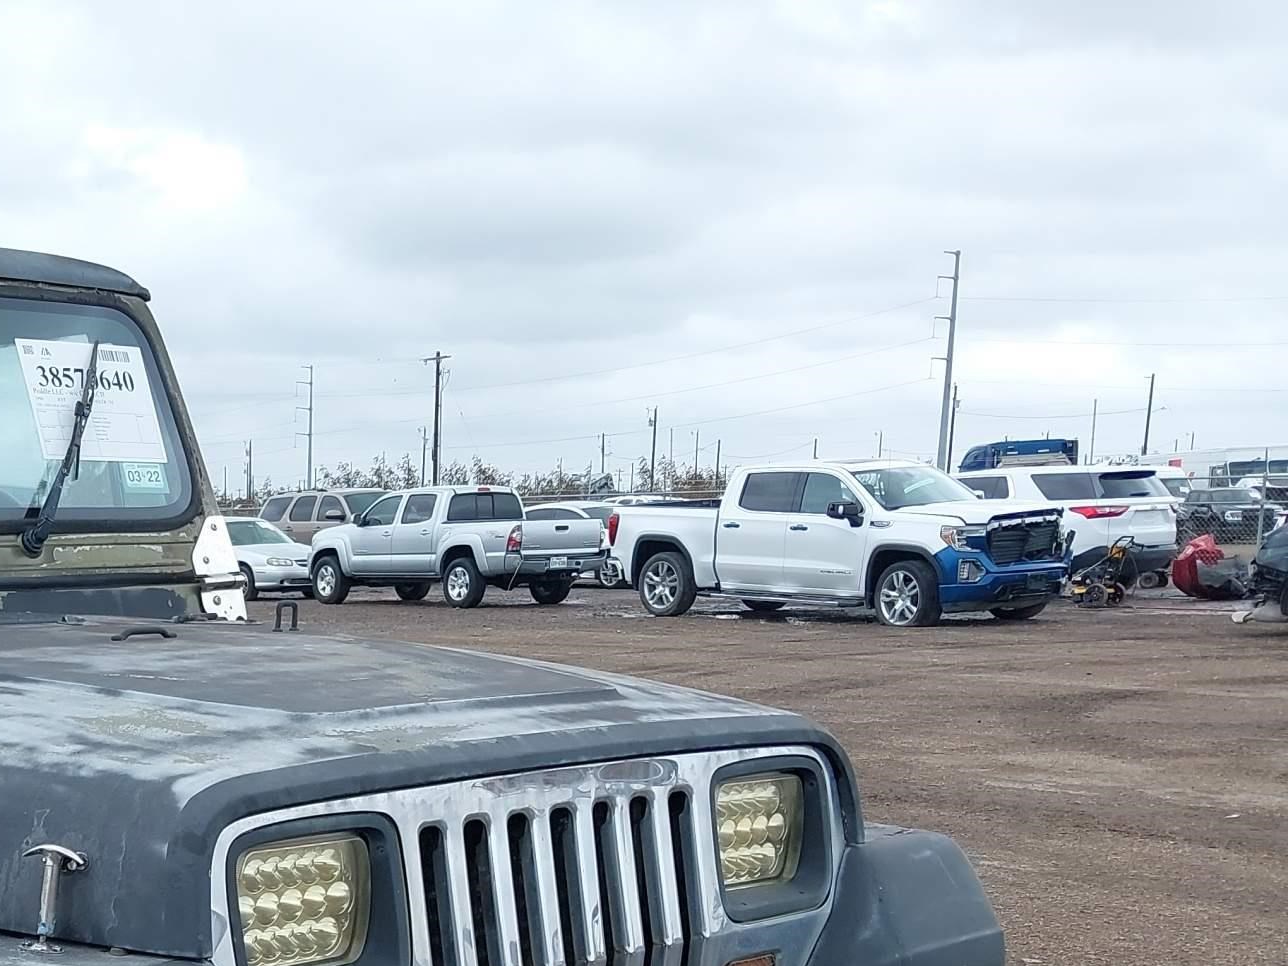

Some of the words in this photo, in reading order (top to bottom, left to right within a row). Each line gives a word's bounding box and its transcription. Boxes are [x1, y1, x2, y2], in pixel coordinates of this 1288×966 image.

[35, 365, 134, 392] 3857640
[127, 470, 142, 482] 03
[146, 470, 161, 483] 22
